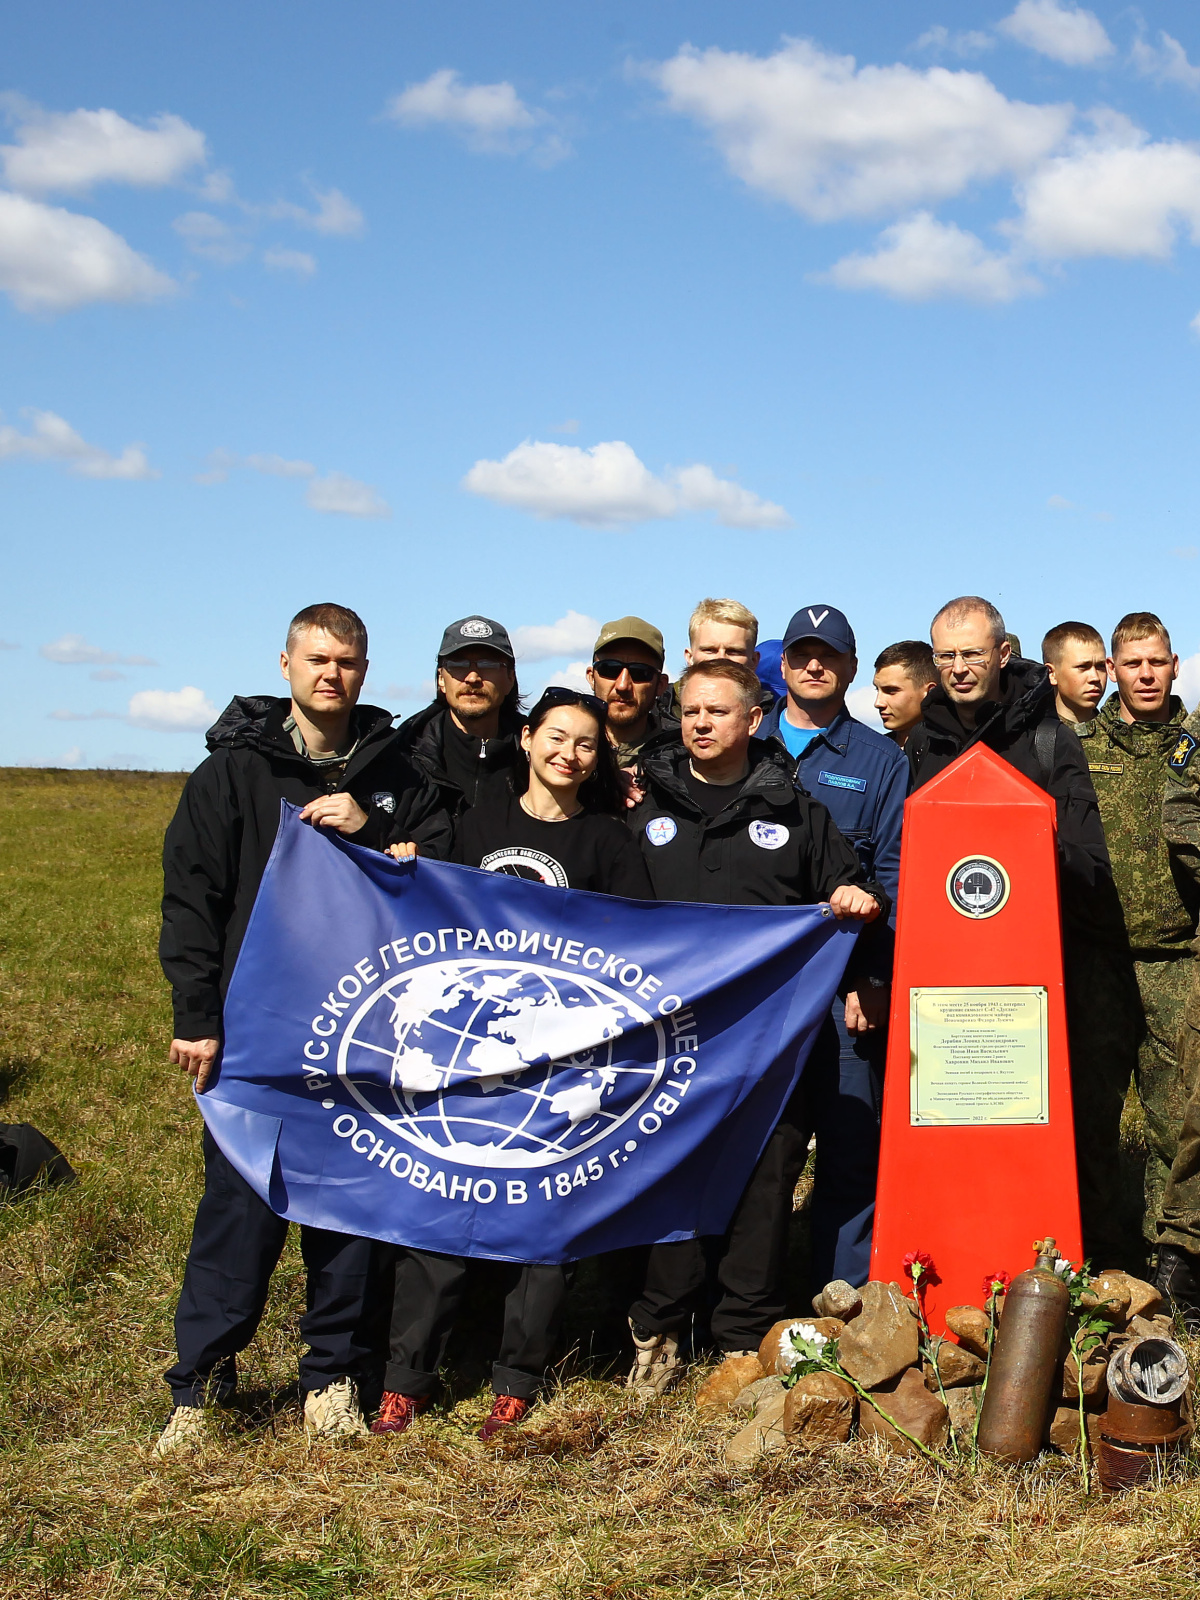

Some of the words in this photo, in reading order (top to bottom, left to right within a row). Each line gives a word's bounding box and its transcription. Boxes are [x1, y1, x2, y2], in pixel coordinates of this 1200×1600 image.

[807, 608, 830, 629] V
[301, 956, 380, 1091] РУССКОЕ
[378, 928, 663, 1002] ГЕОГРАФИЧЕСКОЕ
[332, 1113, 498, 1205] ОСНОВАНО
[506, 1180, 529, 1205] В
[538, 1156, 605, 1201] 1845
[608, 1147, 629, 1169] г.
